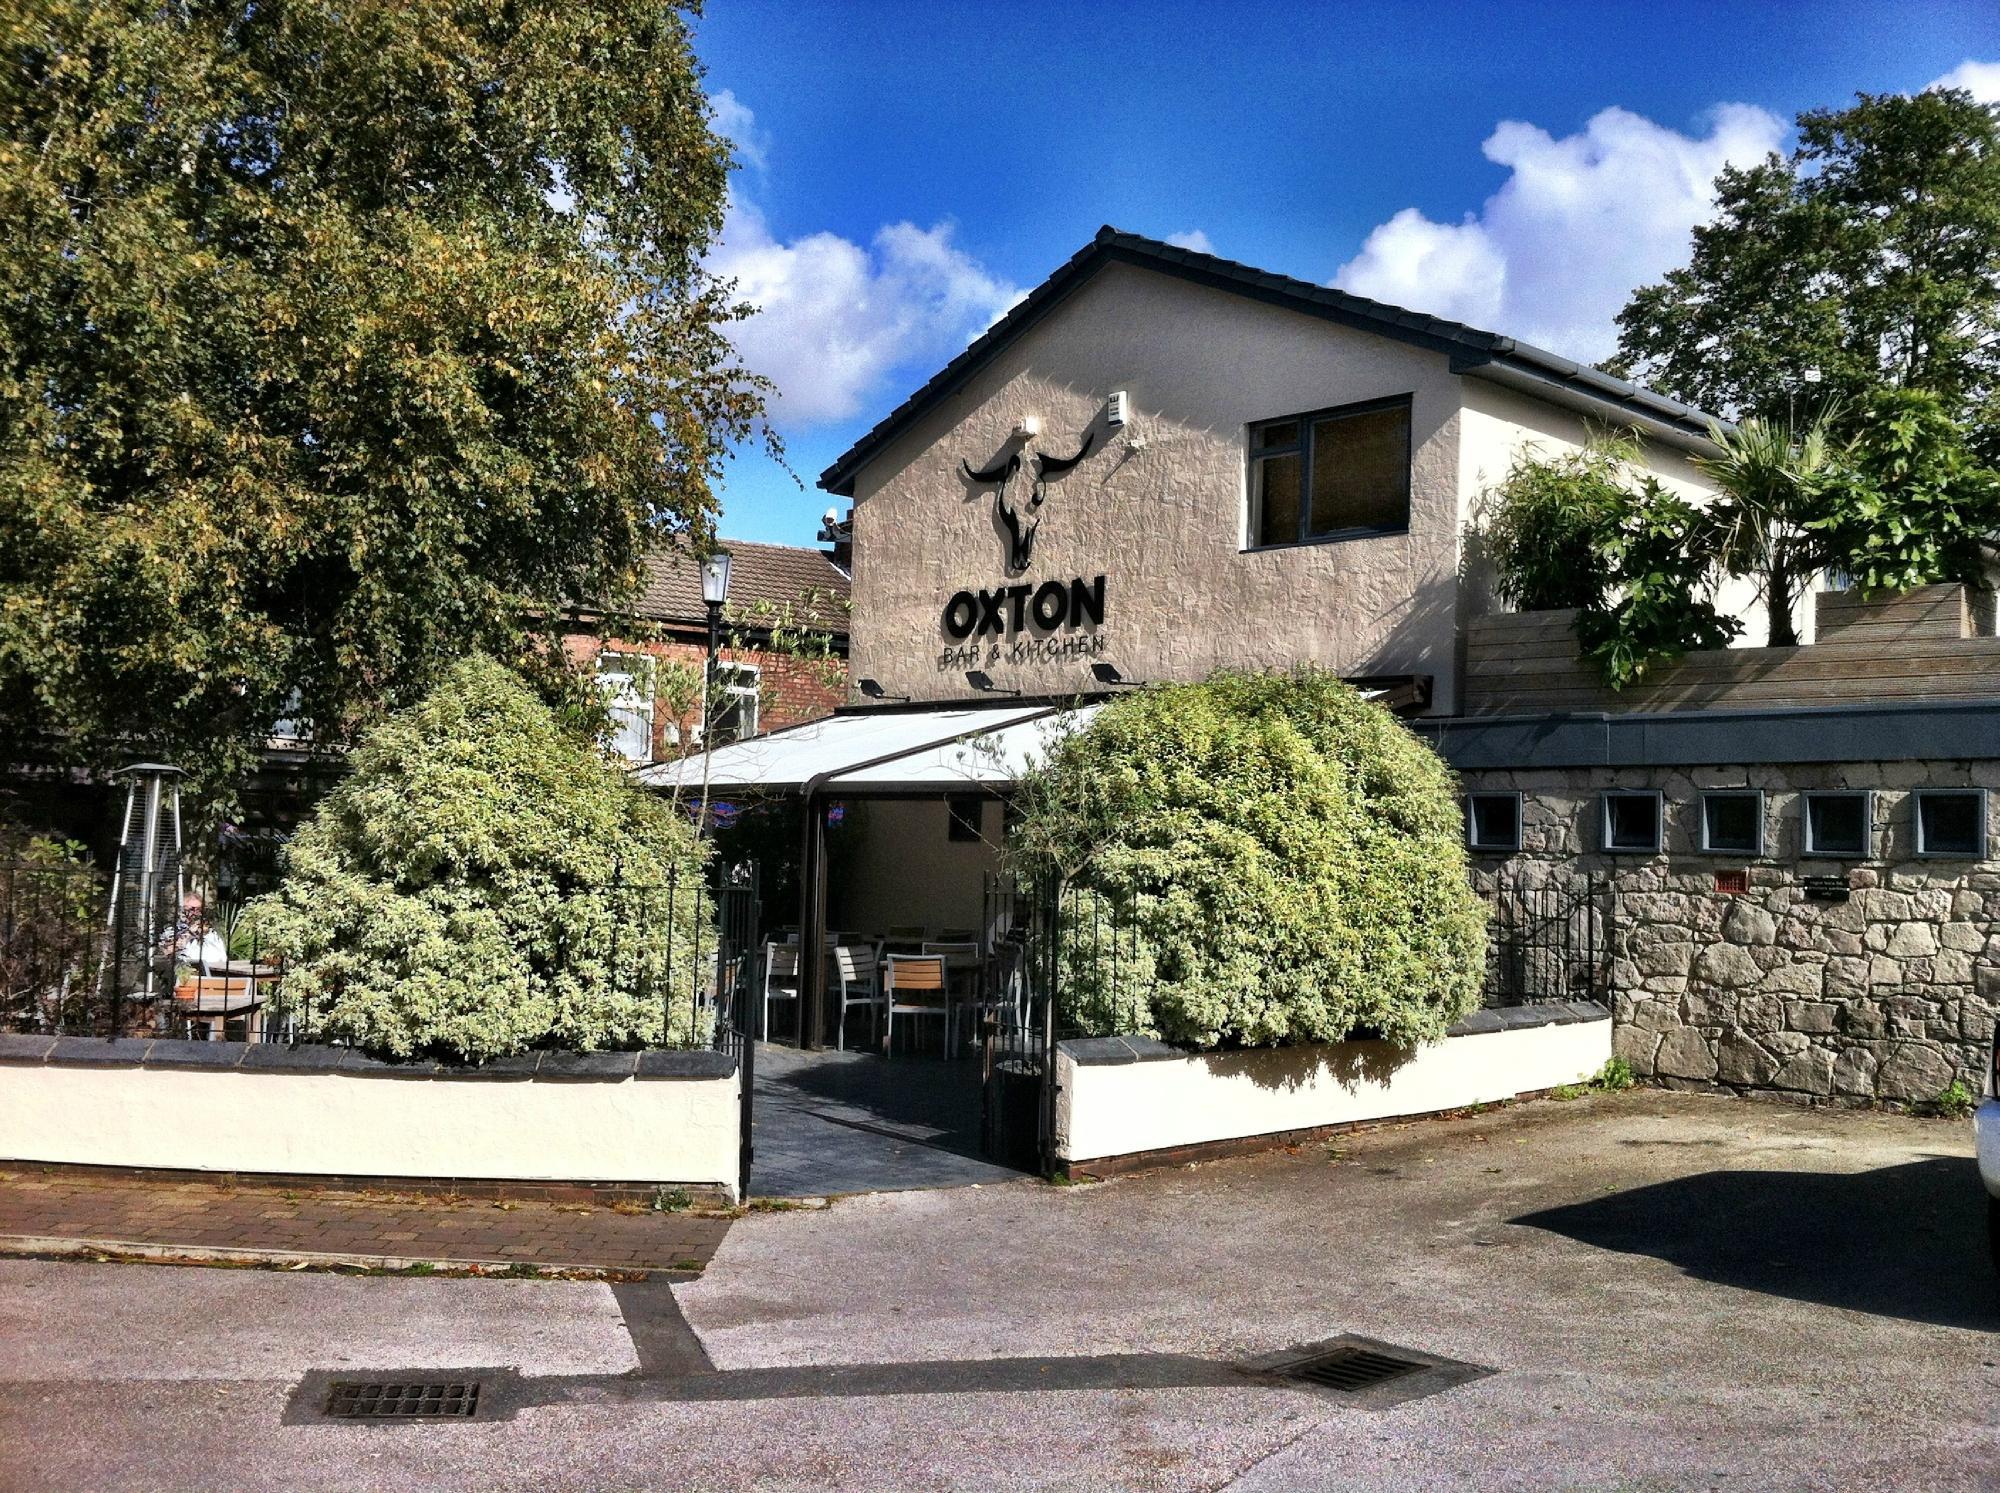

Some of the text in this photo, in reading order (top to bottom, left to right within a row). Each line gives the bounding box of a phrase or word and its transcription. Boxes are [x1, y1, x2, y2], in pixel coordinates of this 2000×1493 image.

[946, 576, 1104, 638] OXTON
[943, 635, 1104, 663] BAR & KITCHEN
